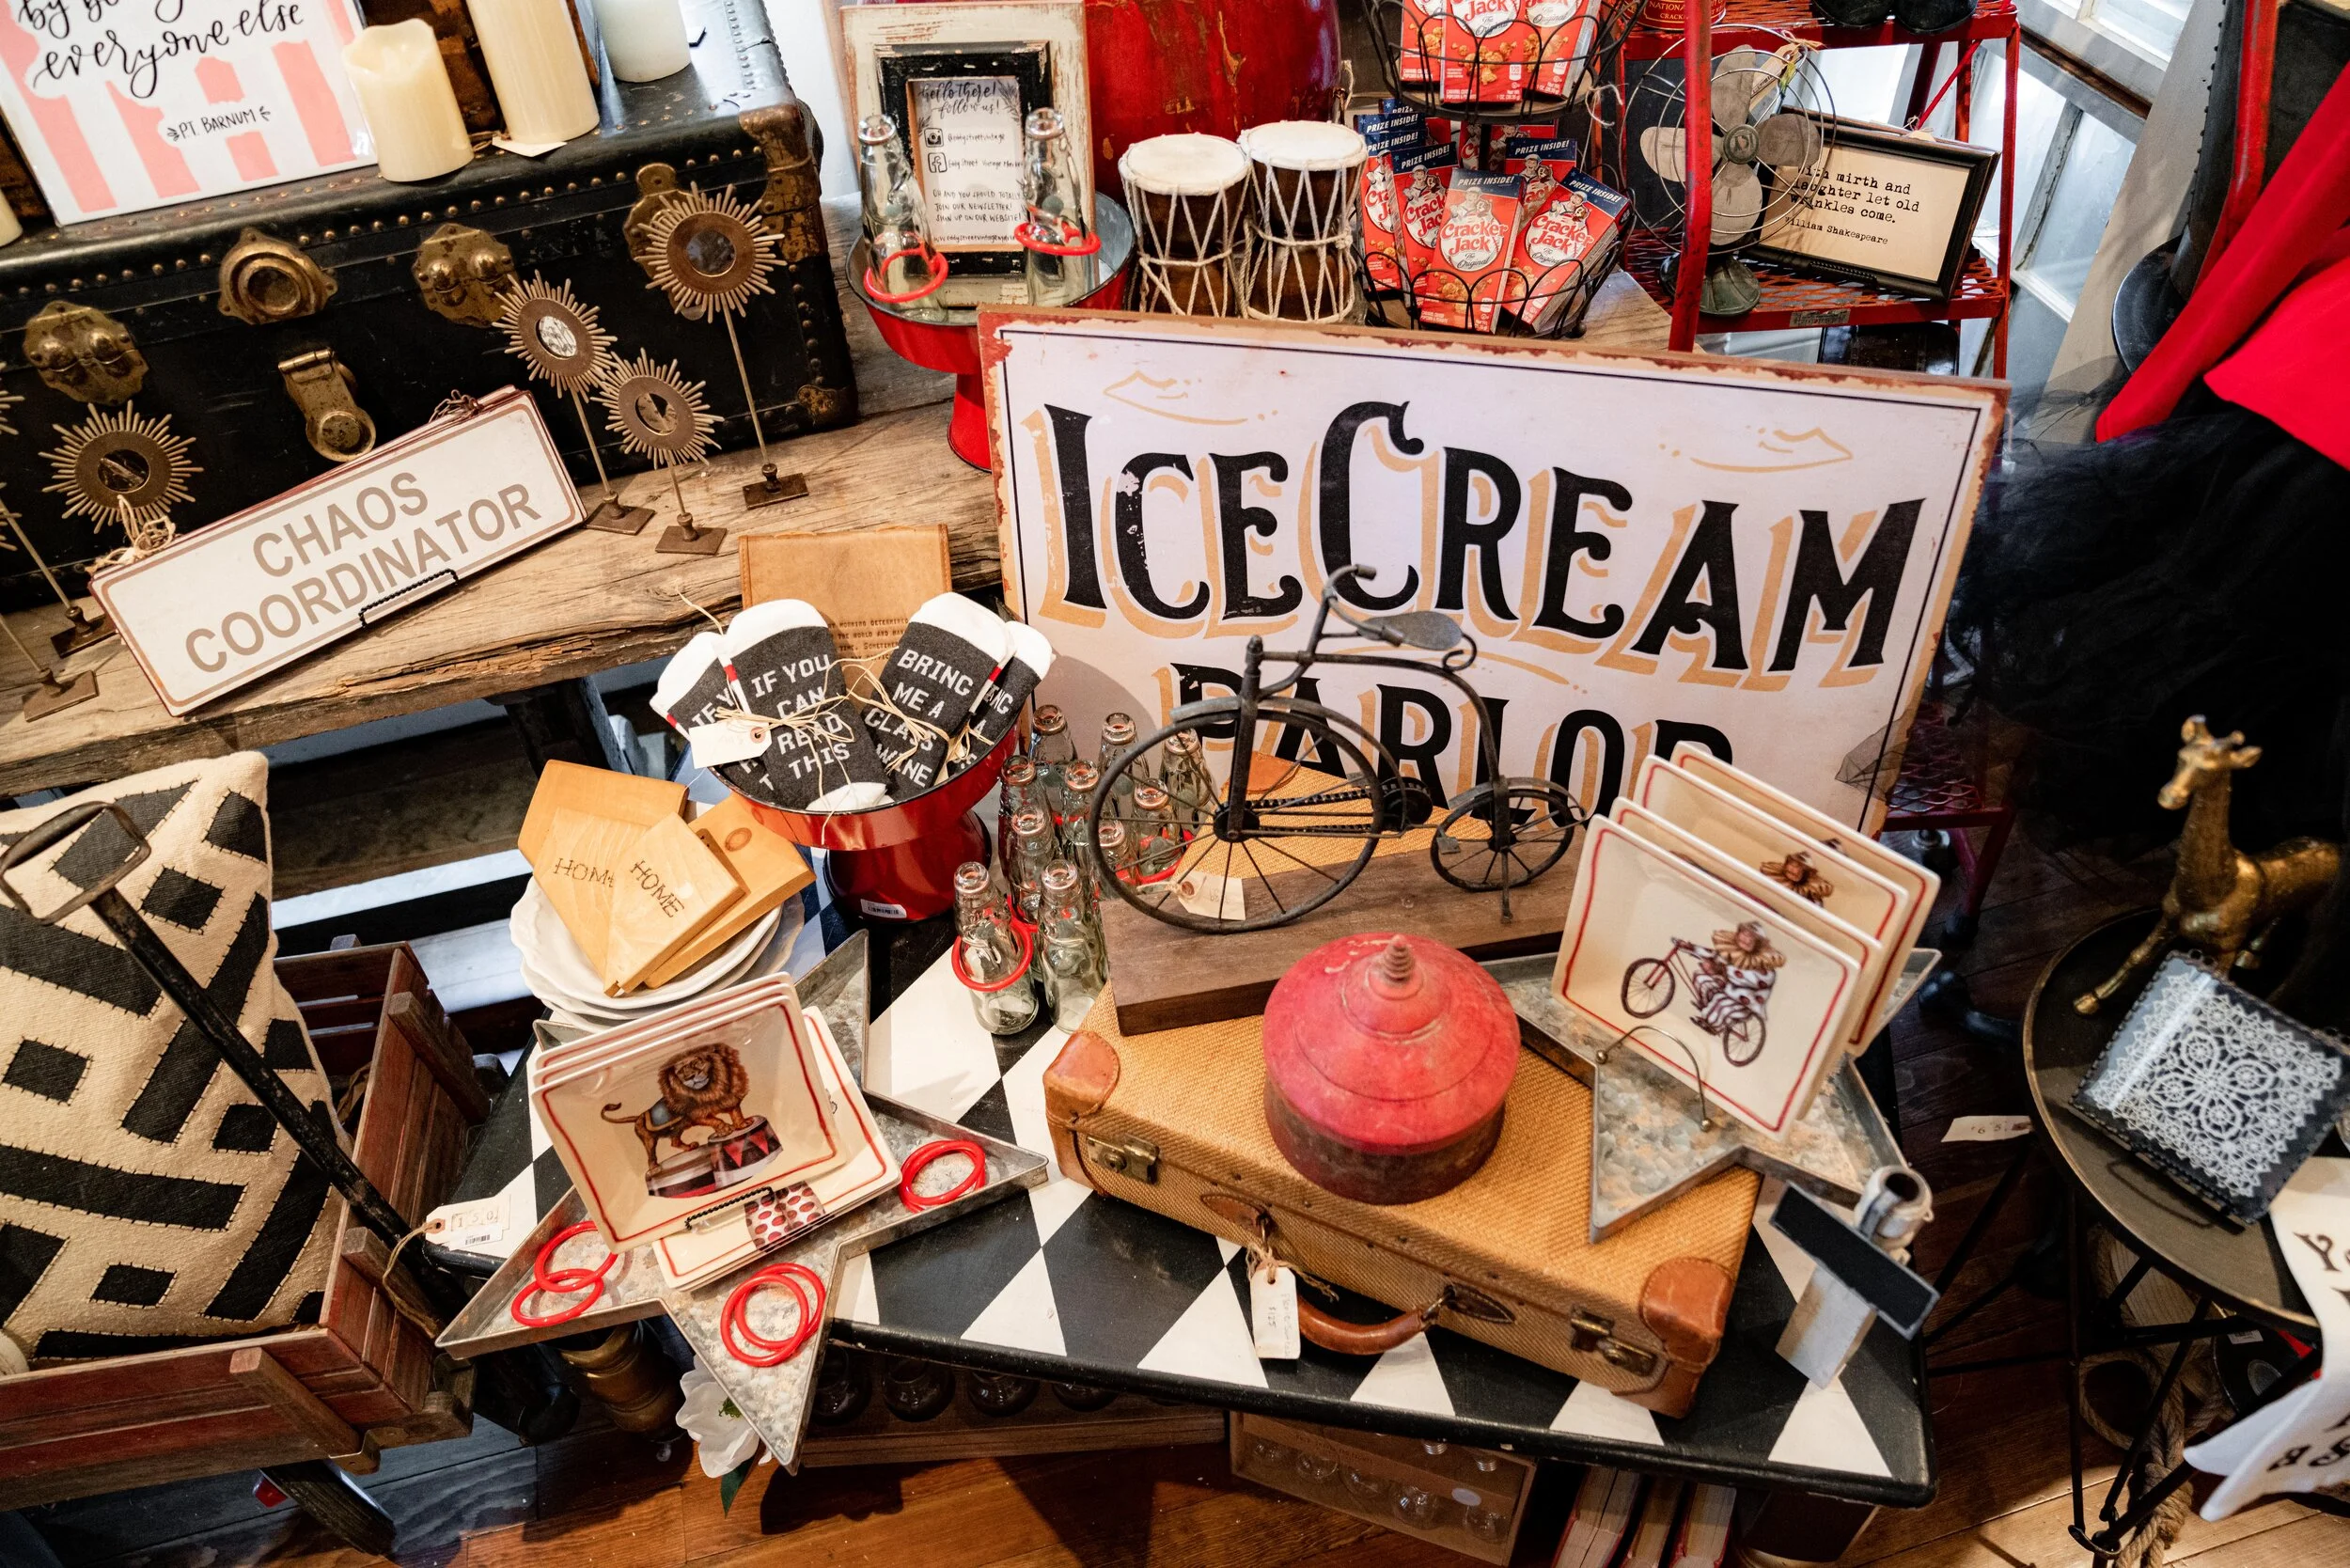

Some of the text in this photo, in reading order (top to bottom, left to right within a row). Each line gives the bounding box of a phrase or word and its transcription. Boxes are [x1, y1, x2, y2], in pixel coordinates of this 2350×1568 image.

[33, 0, 305, 99] everyone else
[201, 109, 258, 135] BARNUM
[1367, 113, 1418, 133] PRIZE INSIDE!
[1368, 132, 1418, 151] PRIZE INSIDE!
[1514, 139, 1570, 155] PRIZE INSIDE!
[1401, 156, 1422, 169] PRIZE
[1424, 144, 1449, 161] INSIDE!
[1458, 176, 1515, 186] PRIZE INSIDE!
[1569, 180, 1623, 203] PRIZE INSIDE!
[1836, 173, 1879, 189] mirth
[1885, 182, 1911, 196] and
[944, 189, 956, 198] AND
[973, 190, 995, 198] SHOULD
[998, 191, 1021, 200] TOTALLY
[1865, 193, 1890, 206] let
[1896, 200, 1919, 212] old
[934, 203, 949, 212] JOIN
[968, 203, 1012, 212] NEWSLETTER!
[990, 212, 1022, 223] WEBSITE!
[1403, 194, 1447, 224] Crack
[1861, 209, 1896, 224] come.
[1418, 212, 1445, 237] Jac
[1440, 220, 1509, 240] Cracker
[1530, 215, 1595, 247] Cracker
[1826, 225, 1888, 244] Shakespeare
[1449, 235, 1491, 256] Jack
[1530, 228, 1572, 255] Jack
[1457, 256, 1491, 269] Original
[252, 471, 429, 578] CHAOS
[184, 483, 542, 674] COORDINATOR
[870, 618, 909, 626] DETERMINED
[751, 670, 778, 698] IF
[782, 653, 832, 683] YOU
[897, 649, 974, 697] BRING
[776, 686, 826, 719] CAN
[892, 682, 946, 719] ME A
[776, 713, 844, 756] READ
[788, 742, 851, 780] THIS
[629, 859, 686, 919] HOME
